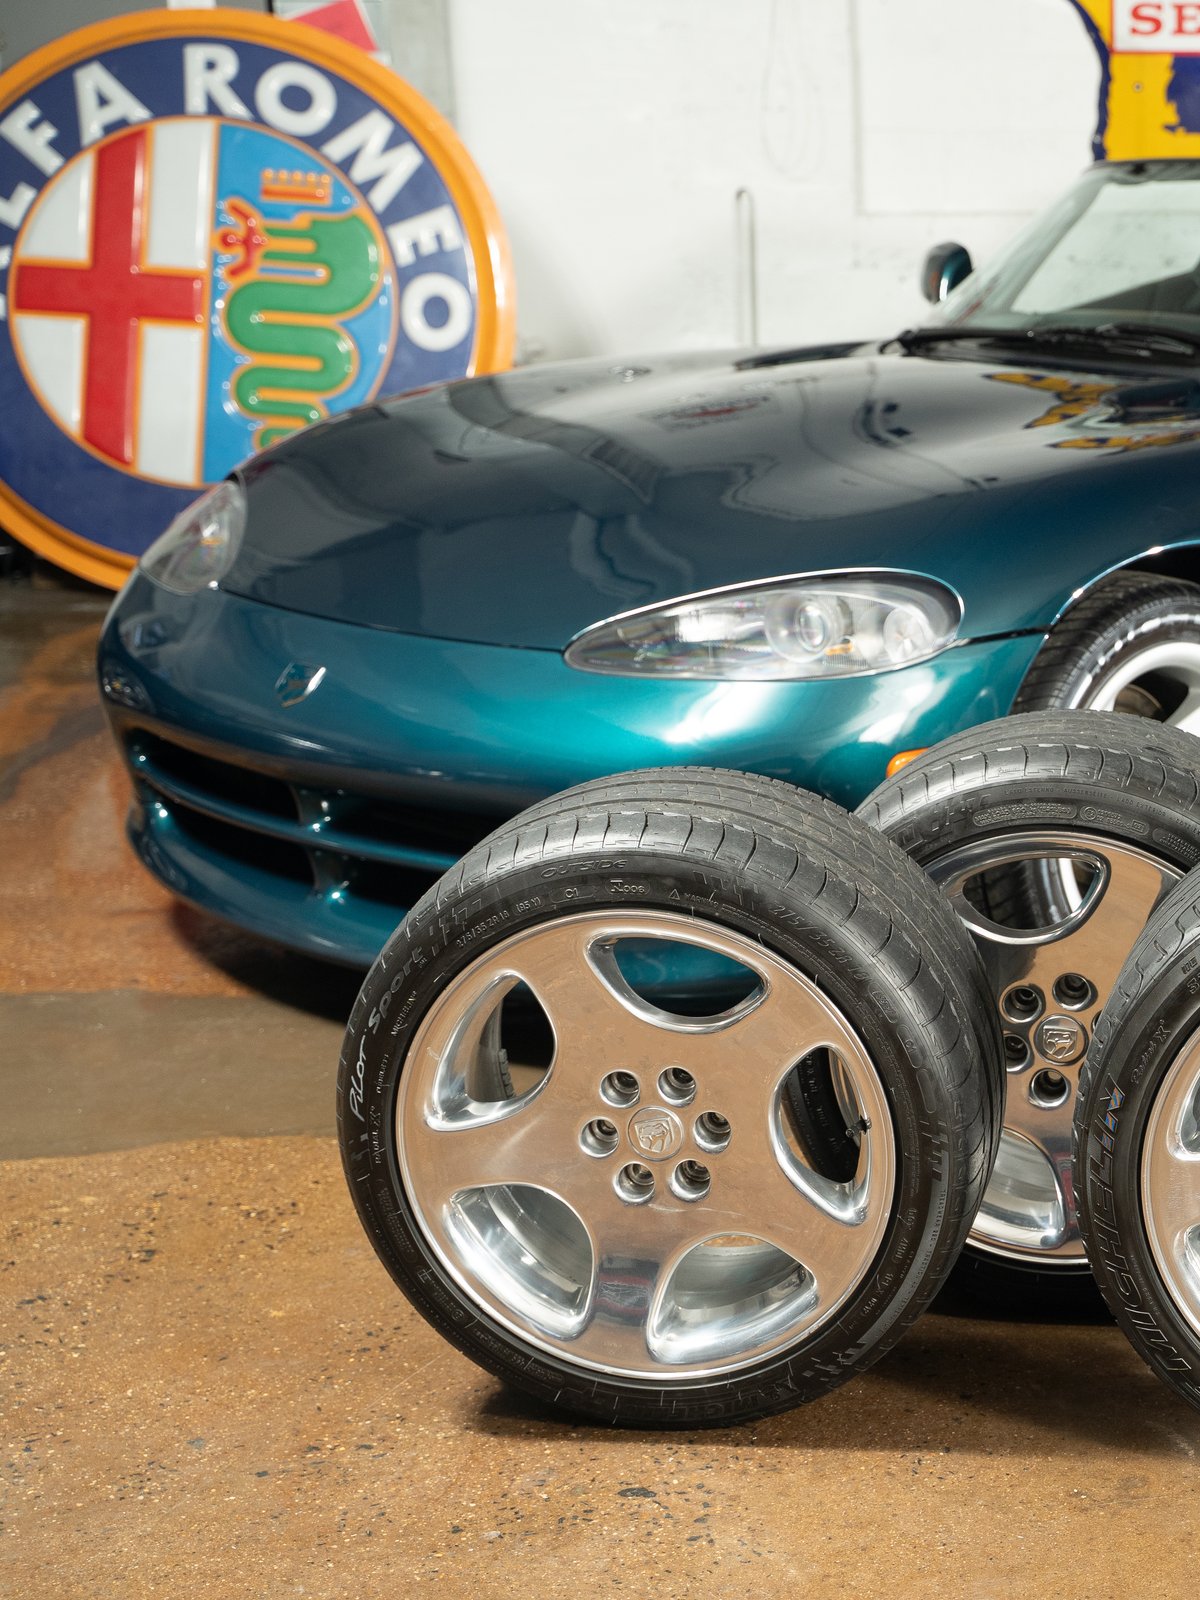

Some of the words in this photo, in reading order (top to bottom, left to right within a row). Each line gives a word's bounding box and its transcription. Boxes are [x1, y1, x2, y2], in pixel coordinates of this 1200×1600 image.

[183, 43, 473, 352] ROMEO
[540, 859, 629, 879] OUTSIDE
[564, 887, 579, 898] C1
[1088, 1073, 1192, 1371] MICHELIN
